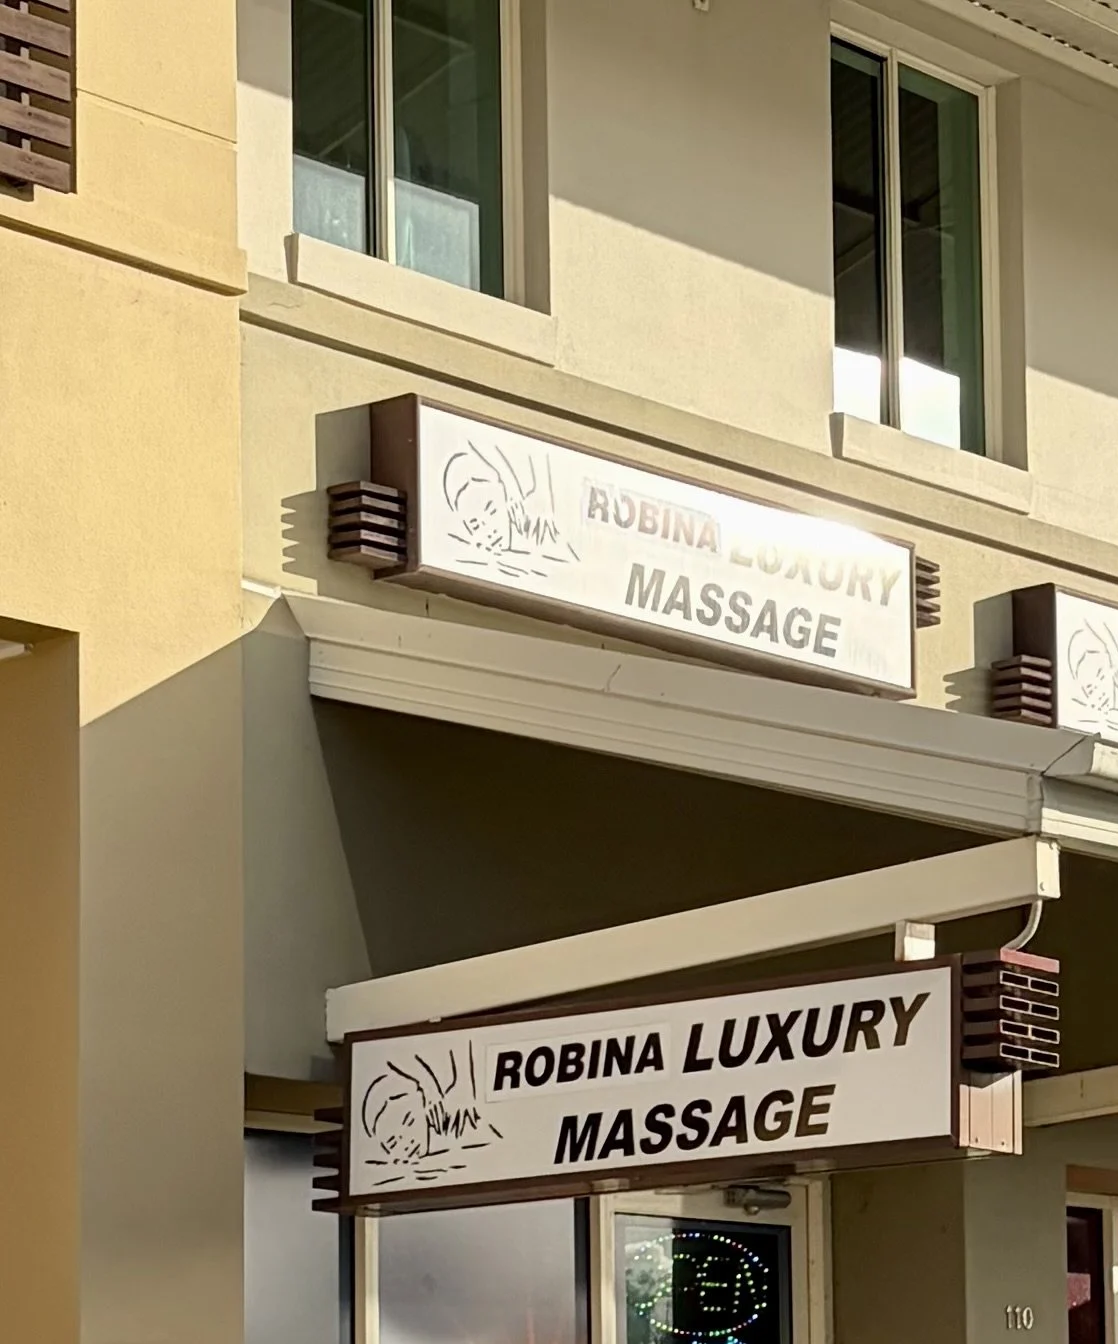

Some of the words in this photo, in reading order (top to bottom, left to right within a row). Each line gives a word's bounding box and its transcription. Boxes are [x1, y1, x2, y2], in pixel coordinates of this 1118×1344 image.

[587, 485, 720, 553] ROBINA
[729, 530, 902, 606] LUXURY
[624, 563, 842, 657] MASSAGE
[493, 1032, 664, 1091] ROBINA
[682, 992, 931, 1074] LUXURY
[553, 1084, 836, 1164] MASSAGE
[1005, 1304, 1034, 1330] 110
